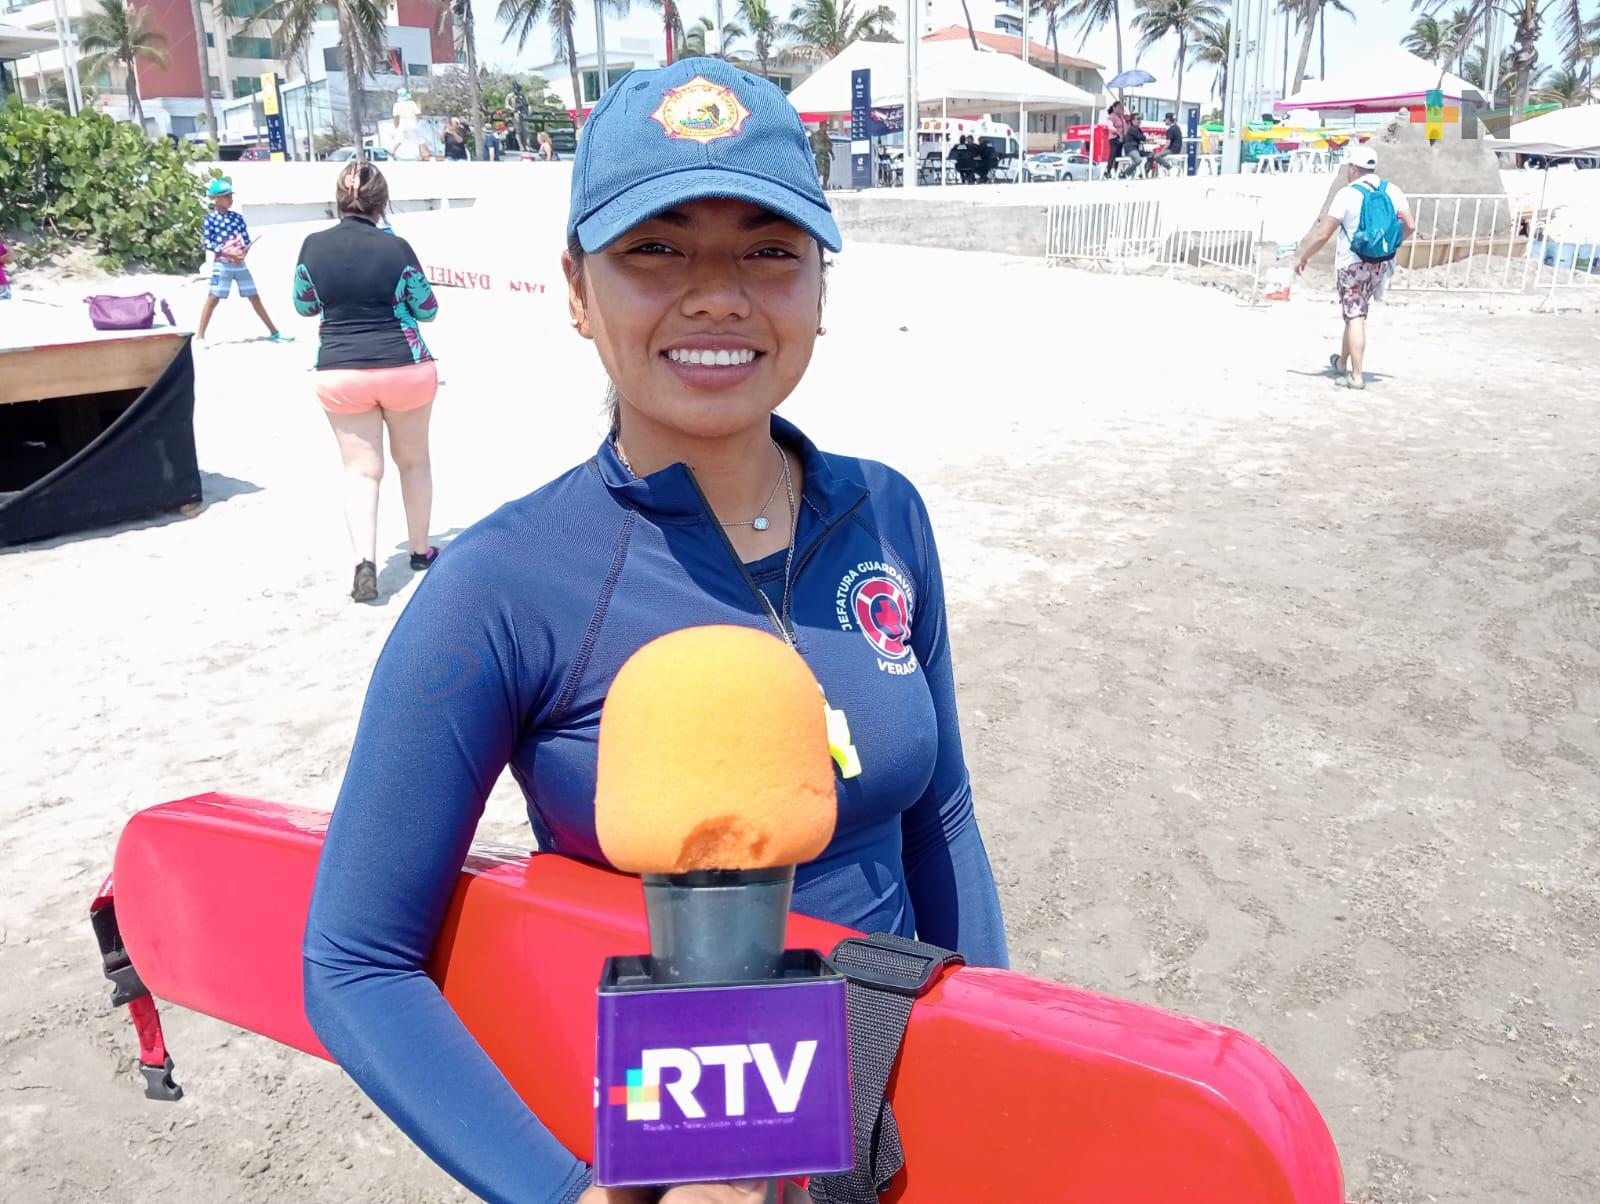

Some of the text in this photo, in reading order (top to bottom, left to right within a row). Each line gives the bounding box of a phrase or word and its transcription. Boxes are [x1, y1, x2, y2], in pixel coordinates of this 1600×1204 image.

[426, 265, 491, 290] DANIEL
[836, 569, 859, 632] JEFATURA
[876, 656, 918, 676] VERAC
[642, 1040, 818, 1119] RTV
